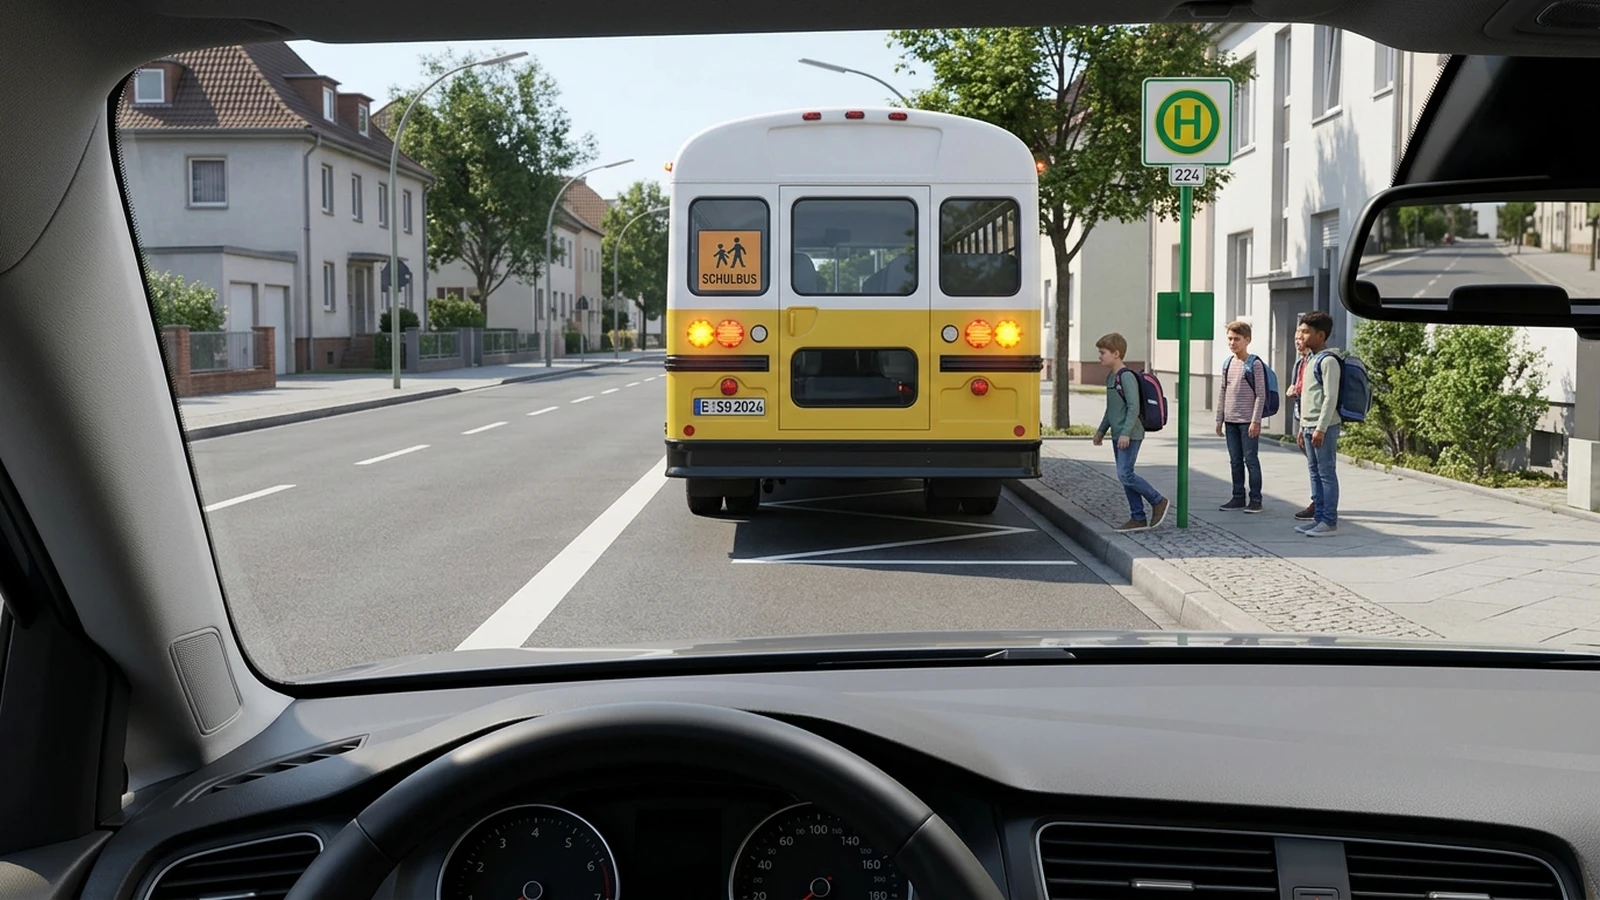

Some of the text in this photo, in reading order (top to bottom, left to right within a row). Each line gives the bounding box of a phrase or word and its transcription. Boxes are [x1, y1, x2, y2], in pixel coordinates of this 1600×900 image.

[1174, 105, 1201, 140] H
[1175, 169, 1200, 181] 224
[702, 273, 757, 285] SCHULBUS
[531, 827, 540, 838] 4
[810, 825, 828, 835] 100
[499, 838, 507, 849] 3
[779, 836, 794, 846] 60
[841, 836, 860, 846] 140
[476, 861, 485, 873] 2
[586, 860, 595, 872] 6
[757, 860, 772, 870] 40
[862, 859, 881, 870] 160
[753, 891, 767, 900] 20
